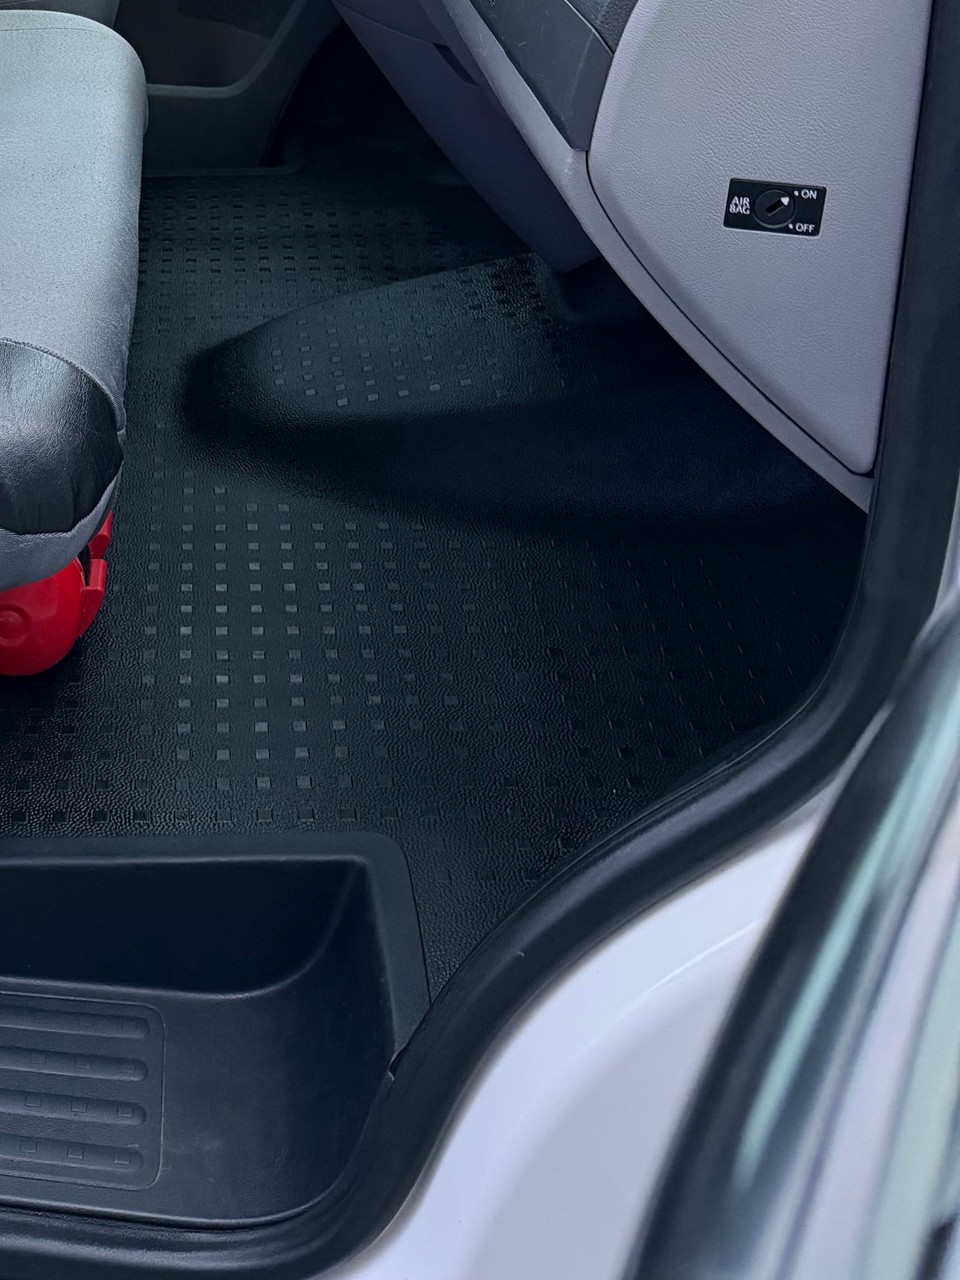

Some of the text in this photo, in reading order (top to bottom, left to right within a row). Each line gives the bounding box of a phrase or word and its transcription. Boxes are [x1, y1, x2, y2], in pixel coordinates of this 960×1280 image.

[801, 189, 818, 200] ON
[730, 196, 750, 208] AIR
[729, 204, 751, 215] BAG
[795, 223, 815, 233] OFF
